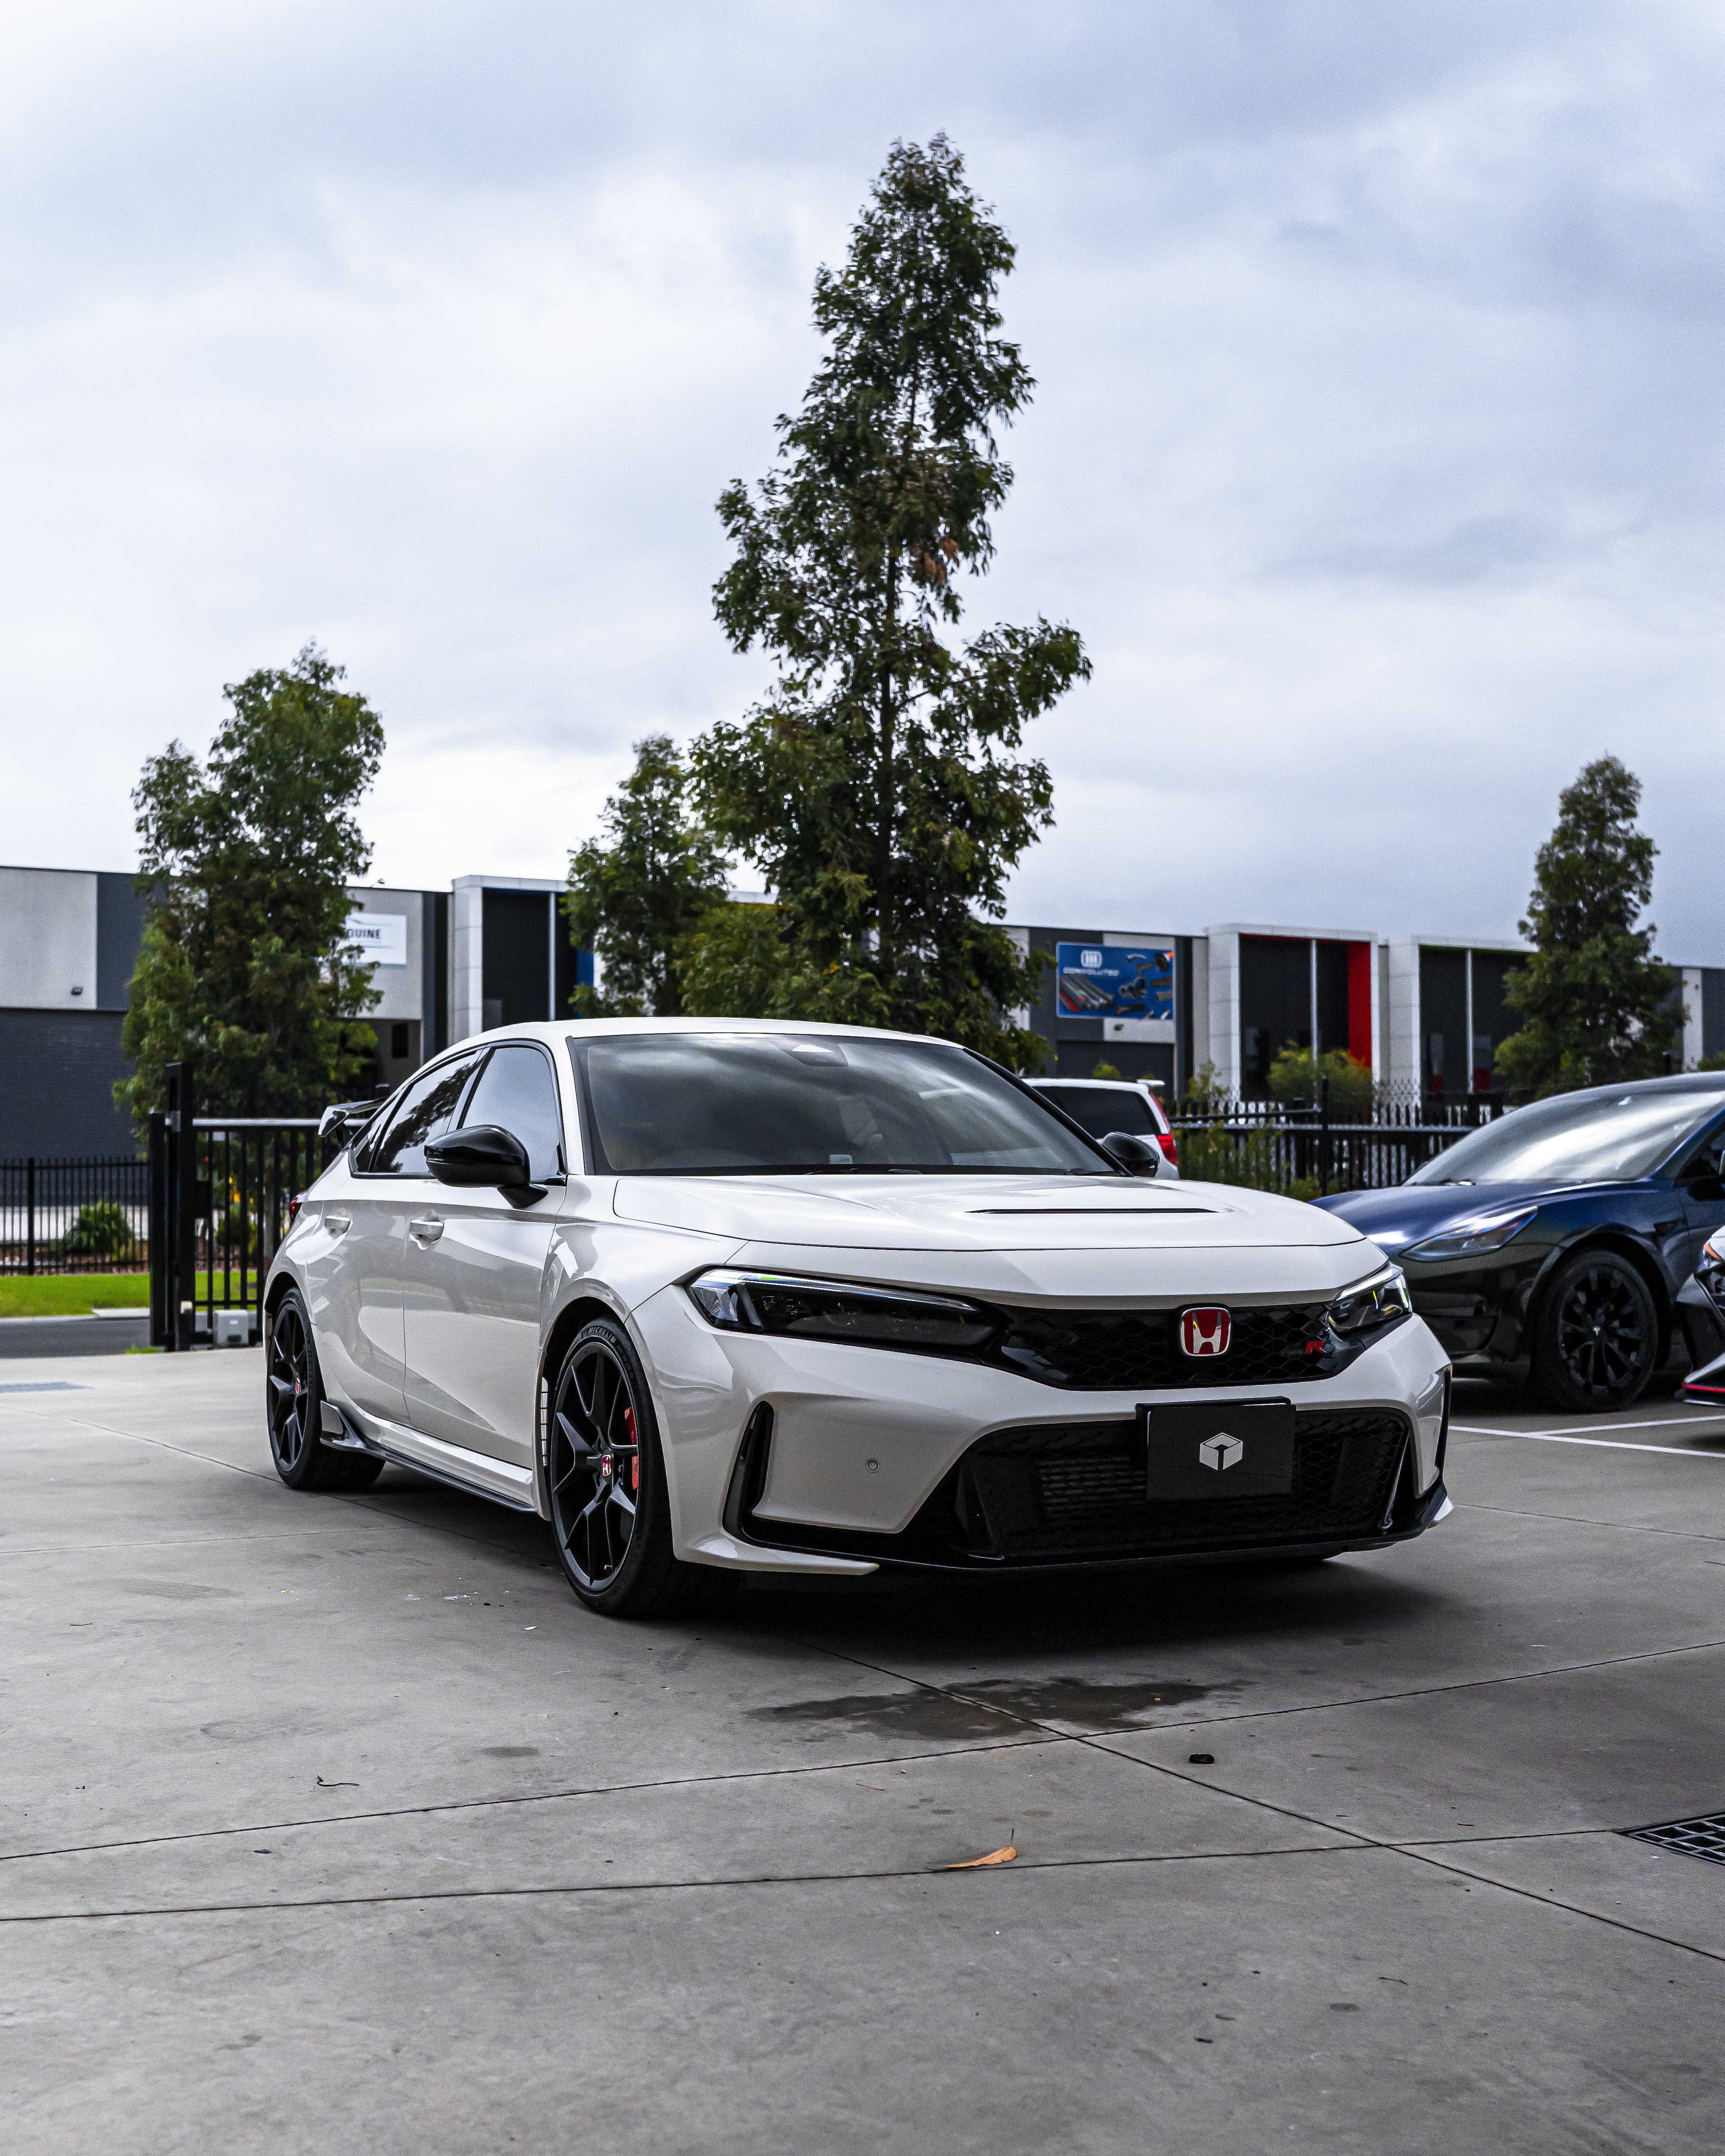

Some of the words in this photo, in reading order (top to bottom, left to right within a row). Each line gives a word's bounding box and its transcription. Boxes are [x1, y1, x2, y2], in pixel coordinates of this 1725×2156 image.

[588, 1326, 617, 1343] MICHELIN
[1192, 1312, 1221, 1353] H
[1305, 1340, 1325, 1354] R
